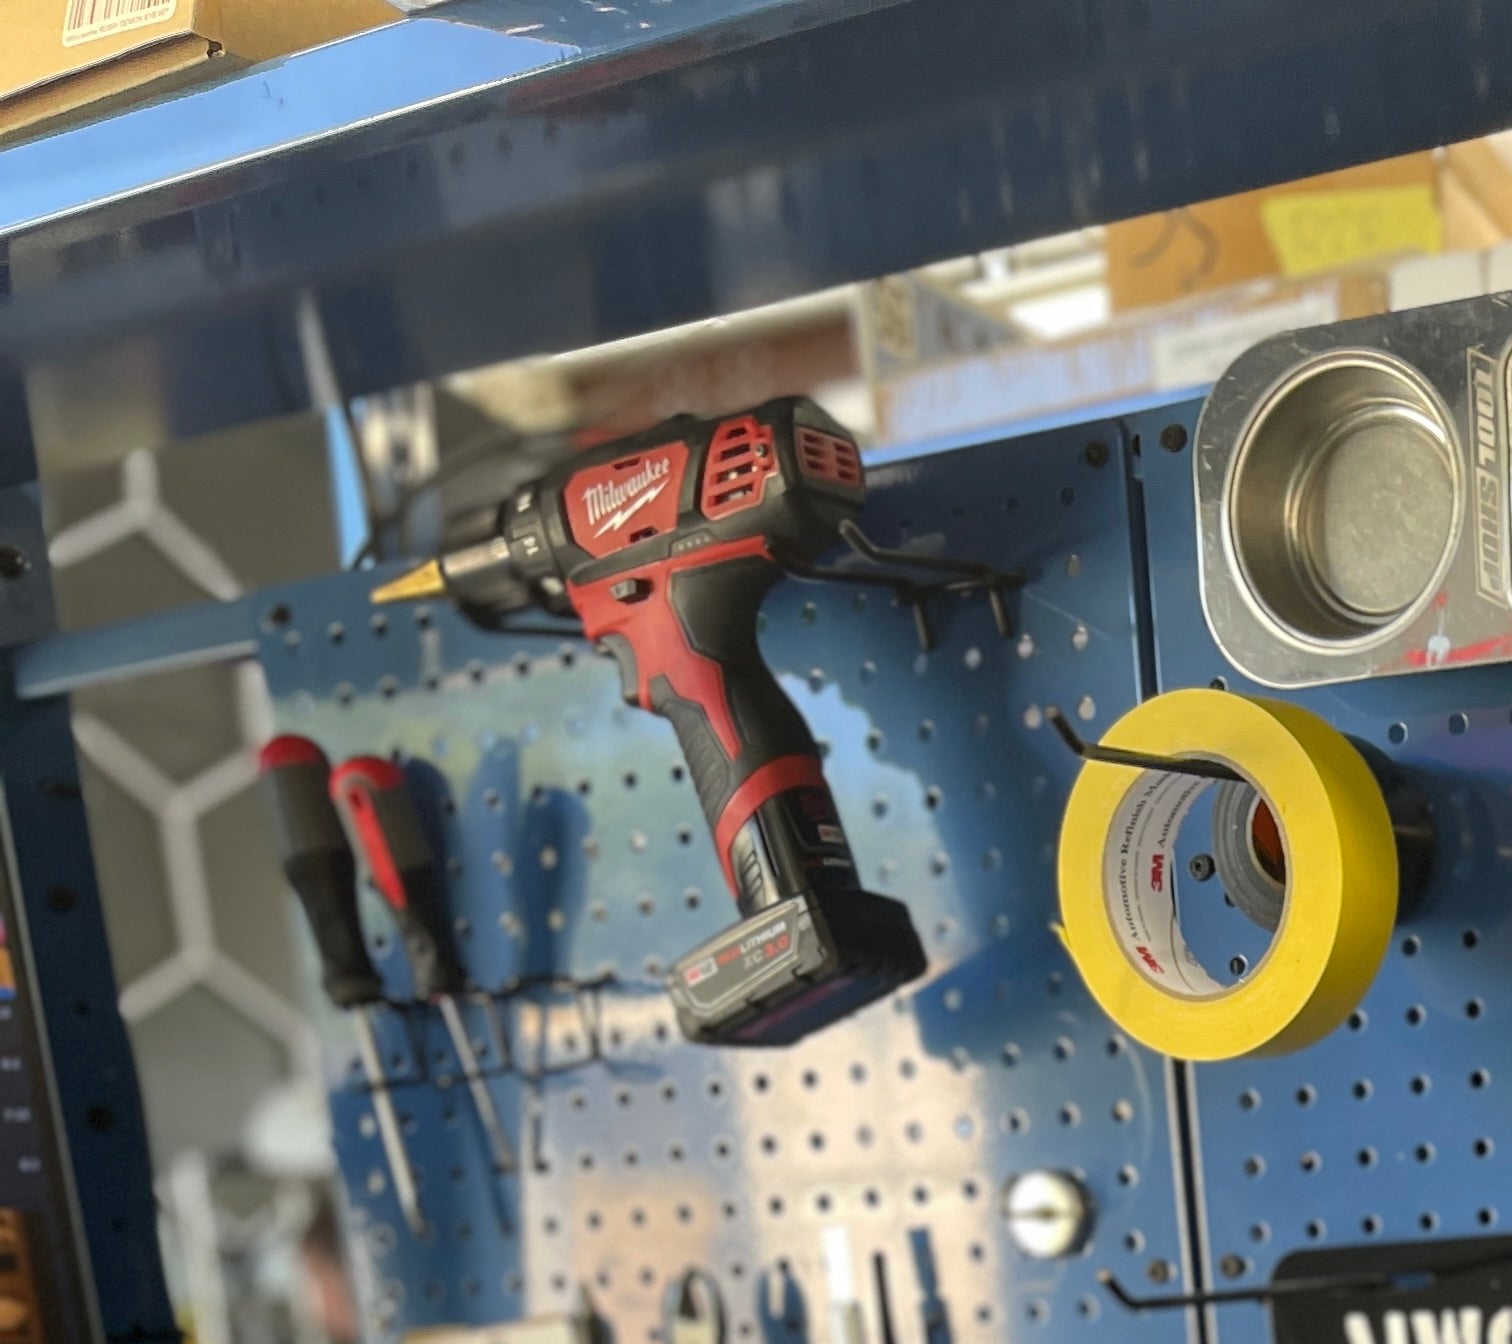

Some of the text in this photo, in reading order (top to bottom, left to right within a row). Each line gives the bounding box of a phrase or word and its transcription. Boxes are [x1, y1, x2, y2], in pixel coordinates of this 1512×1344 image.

[581, 457, 670, 526] Milwaukee
[1120, 795, 1147, 854] Refinish
[1118, 858, 1140, 941] Automotive
[1151, 854, 1164, 892] 3M
